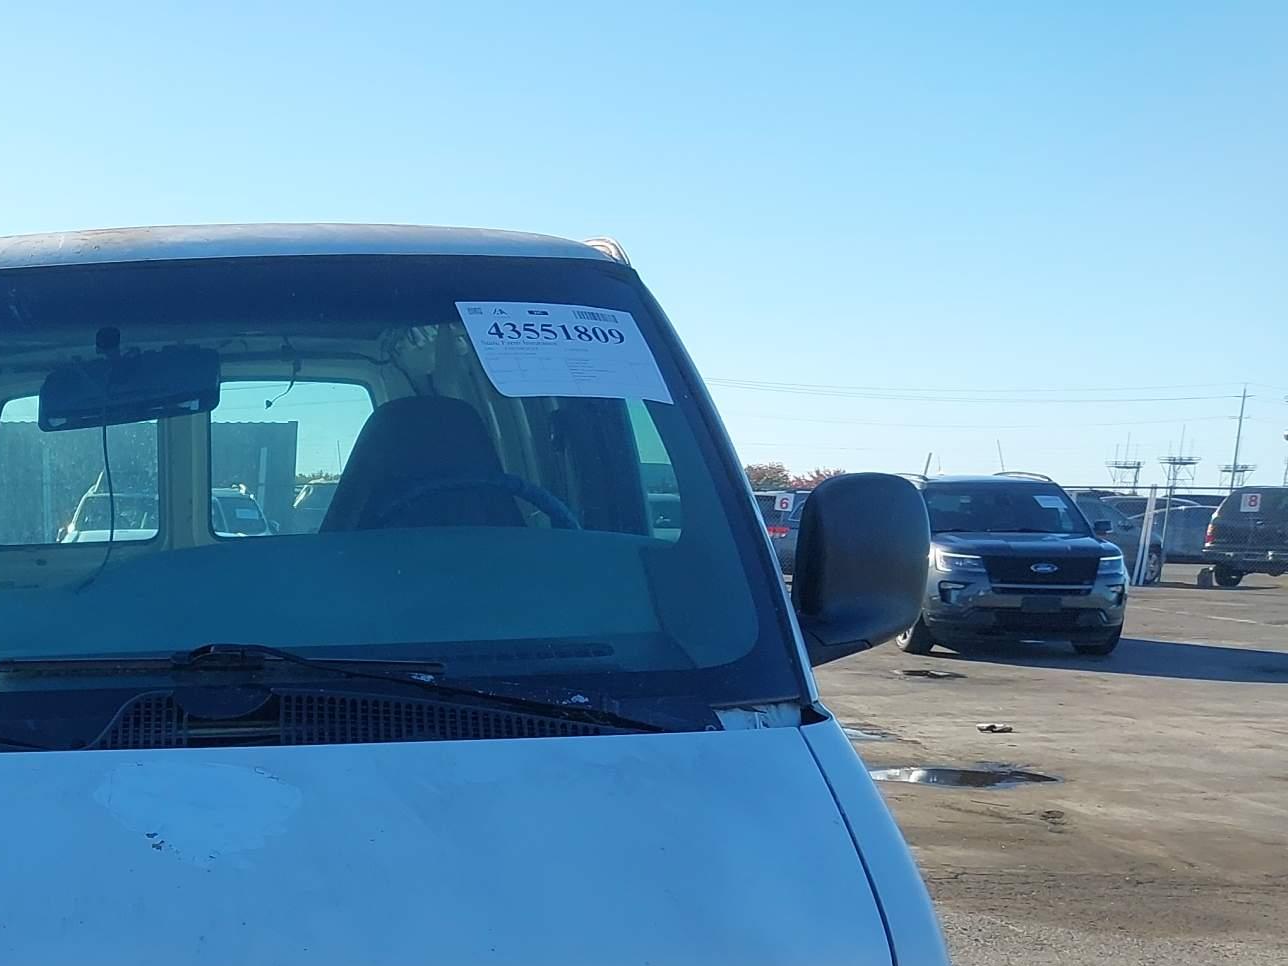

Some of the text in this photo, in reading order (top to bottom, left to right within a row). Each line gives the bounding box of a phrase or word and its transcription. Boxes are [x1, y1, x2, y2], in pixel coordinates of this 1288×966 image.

[487, 321, 625, 345] 43551809
[780, 497, 789, 509] 6
[1248, 495, 1258, 507] 8
